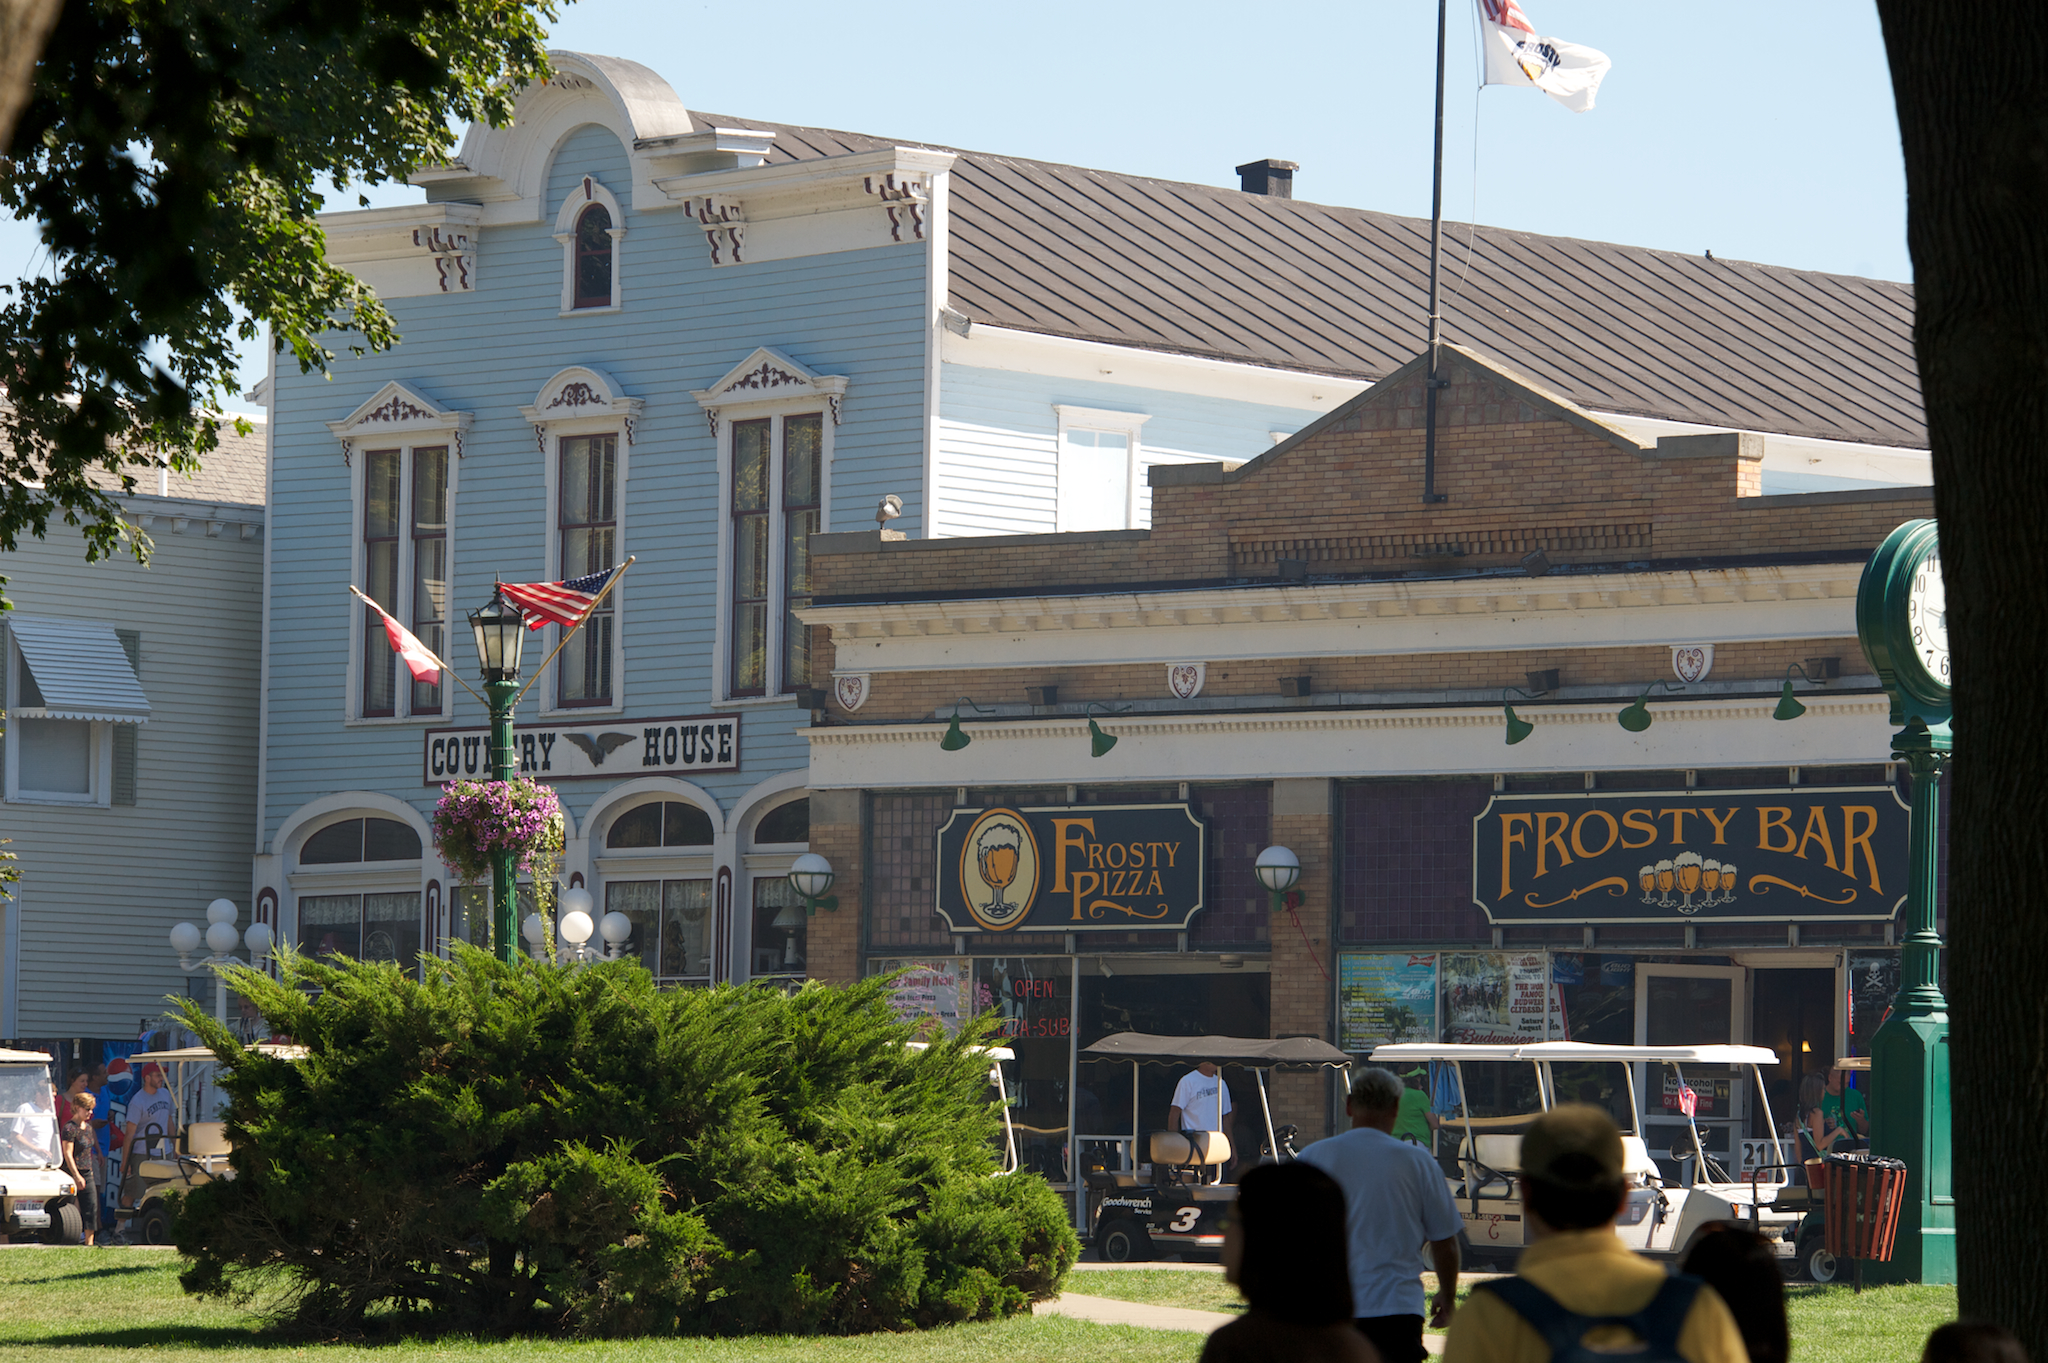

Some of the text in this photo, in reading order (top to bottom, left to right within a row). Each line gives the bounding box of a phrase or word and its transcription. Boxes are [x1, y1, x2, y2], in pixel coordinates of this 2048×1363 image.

[1926, 553, 1937, 573] 11
[1914, 574, 1926, 593] 10
[1910, 600, 1917, 620] 9
[1914, 626, 1923, 646] 8
[1925, 650, 1934, 669] 7
[1940, 656, 1950, 676] 6
[432, 724, 732, 776] COURY HOUSE
[1050, 817, 1181, 893] FROSTY
[1498, 805, 1884, 901] FROSTY BAR
[1070, 870, 1164, 920] PIZZA
[1014, 979, 1053, 998] OPEN
[1515, 983, 1553, 991] THE WORD
[1514, 998, 1556, 1006] BUDWEISR
[1454, 1027, 1535, 1044] Budweiser
[1518, 1023, 1542, 1032] August
[1700, 1099, 1713, 1109] Fine
[1743, 1143, 1766, 1165] 21
[1103, 1196, 1152, 1208] Goodwrench
[1169, 1206, 1202, 1232] 3
